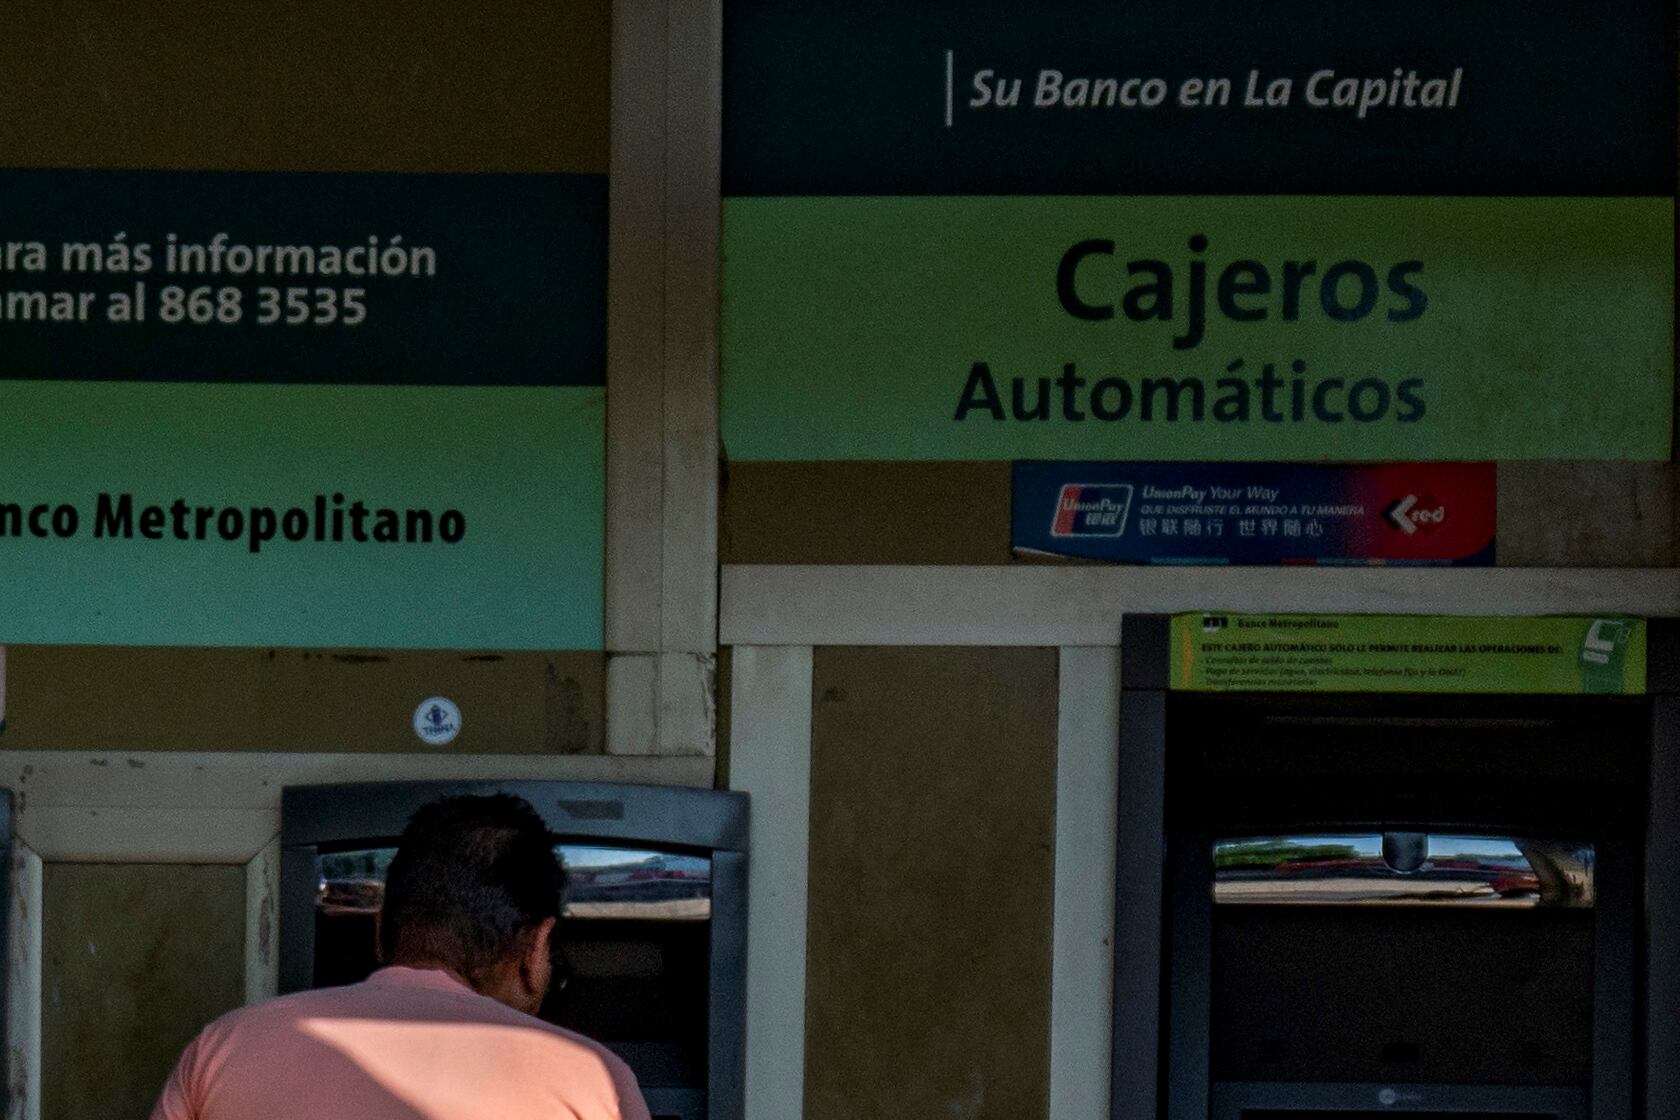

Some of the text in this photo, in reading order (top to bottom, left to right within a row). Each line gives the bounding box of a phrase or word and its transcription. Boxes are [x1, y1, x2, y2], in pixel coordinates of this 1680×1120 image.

[969, 66, 1464, 120] Su Banco en La Capital
[62, 230, 153, 274] más
[166, 232, 436, 279] información
[106, 281, 147, 322] al
[158, 284, 243, 324] 868
[255, 286, 367, 326] 3535
[1055, 233, 1428, 351] Cajeros
[953, 358, 1427, 423] Automáticos
[1063, 497, 1124, 515] UnionPay
[1142, 484, 1280, 504] UnionPay Your Way
[1244, 504, 1288, 516] MUNDO
[1412, 505, 1445, 525] red
[94, 491, 465, 552] Metropolitano
[1268, 619, 1339, 631] Metropolitano
